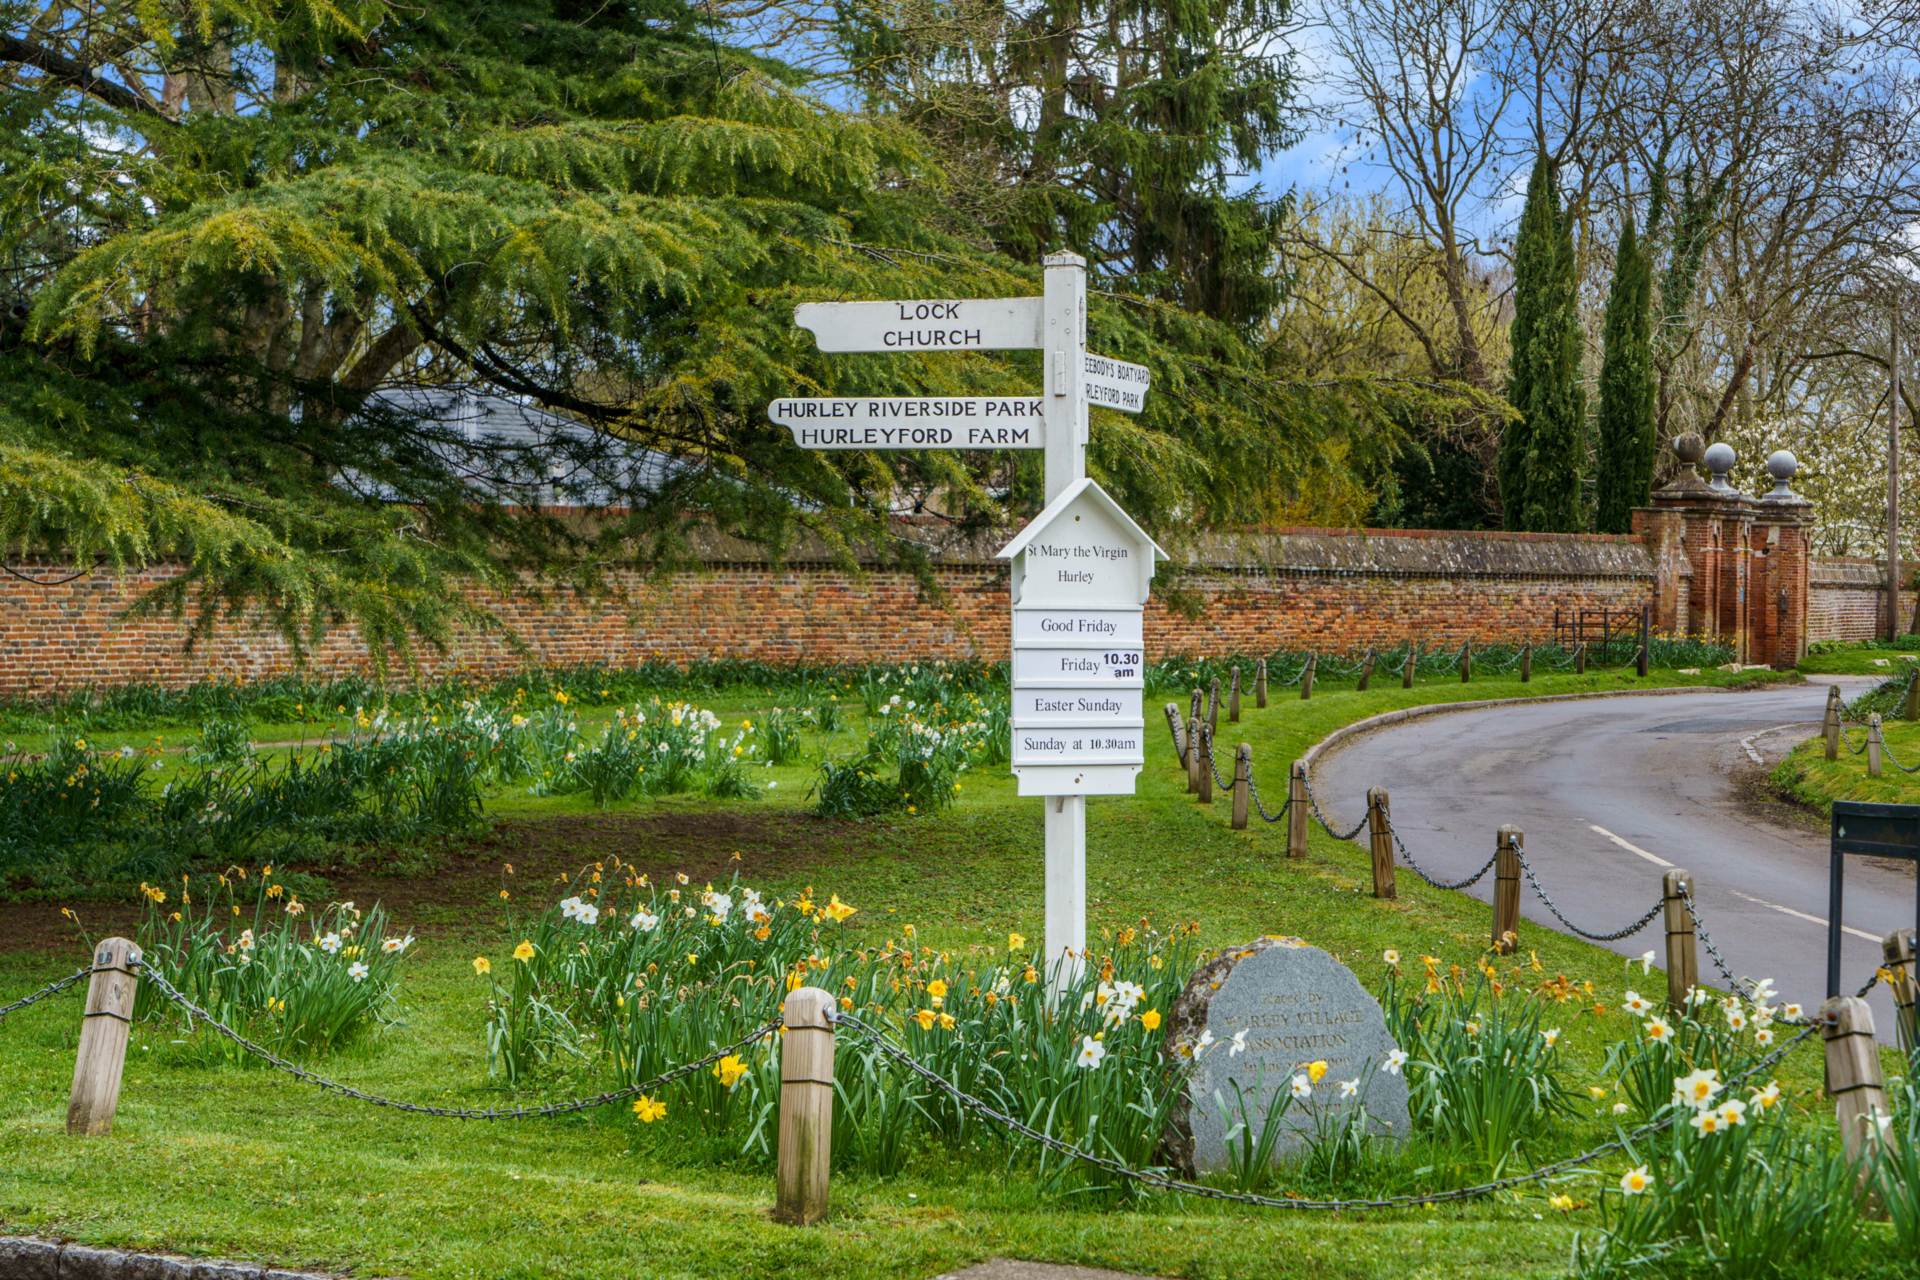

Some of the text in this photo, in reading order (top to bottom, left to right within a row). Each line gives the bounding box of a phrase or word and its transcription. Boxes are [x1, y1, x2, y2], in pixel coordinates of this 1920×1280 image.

[900, 304, 959, 321] LOCK
[884, 329, 981, 346] CHURCH
[1085, 358, 1149, 384] EEBODY'S BOATYARD
[1086, 384, 1139, 408] RLEYFORD PARK
[778, 401, 1043, 418] HURLEY RIVERSIDE PARK
[802, 429, 1029, 444] HURLEYFORD FARM
[1029, 542, 1127, 559] St Mary the Virgin
[1059, 570, 1094, 584] Hurley
[1041, 618, 1116, 636] Good Friday
[1062, 653, 1139, 675] Friday 10.30
[1114, 669, 1134, 678] am
[1036, 698, 1122, 715] Easter Sunday
[1025, 737, 1135, 754] Sunday at 10.30am
[1296, 1009, 1364, 1025] VILLAGE
